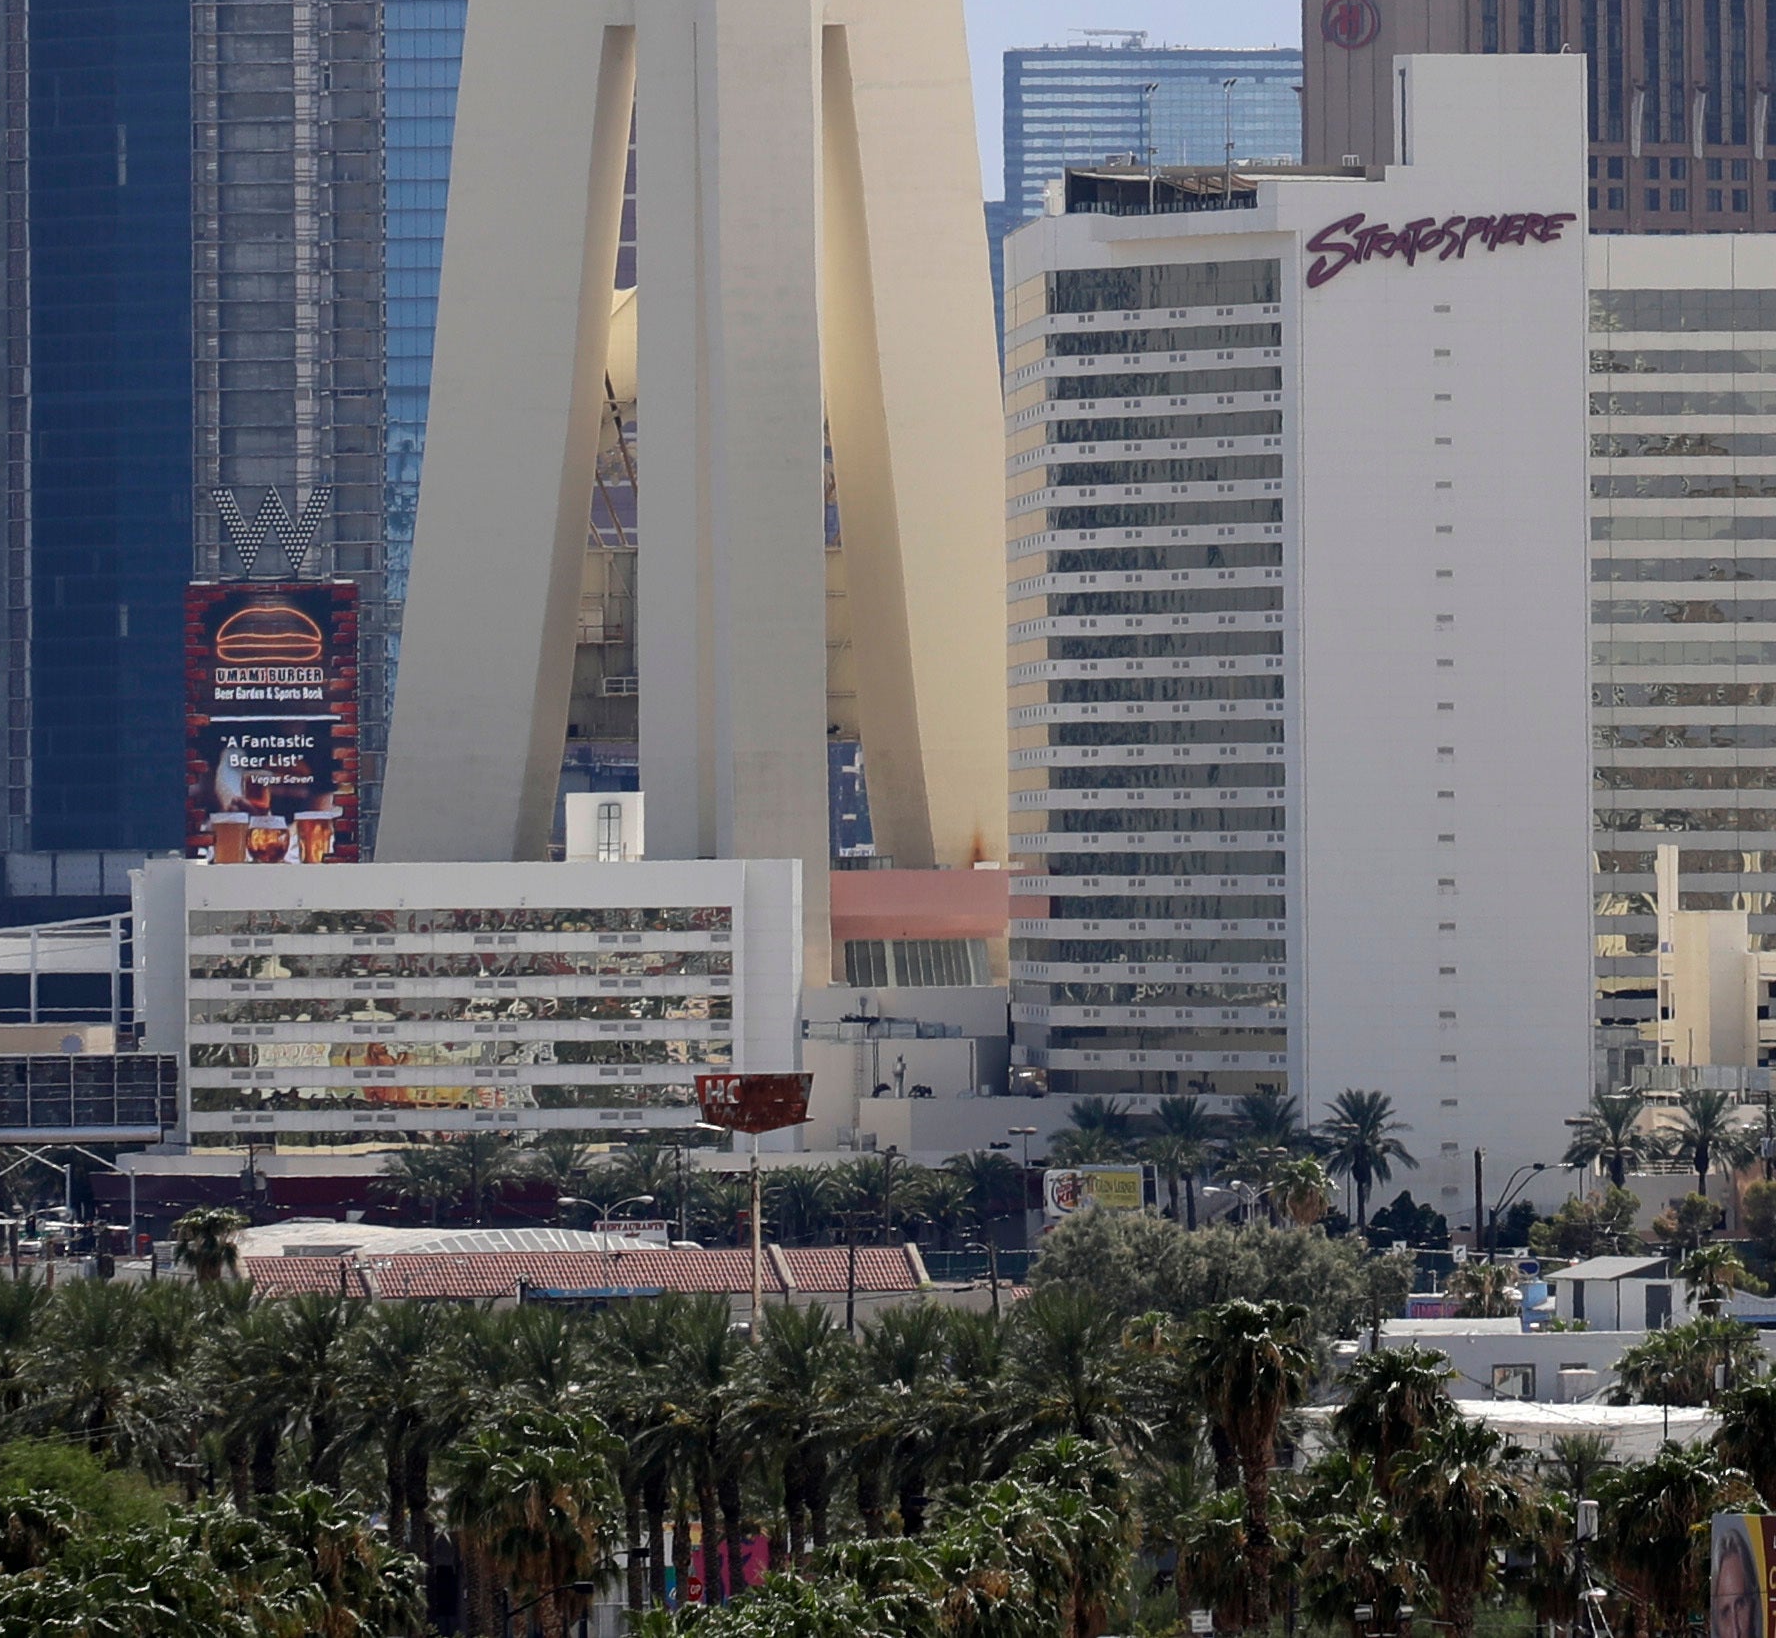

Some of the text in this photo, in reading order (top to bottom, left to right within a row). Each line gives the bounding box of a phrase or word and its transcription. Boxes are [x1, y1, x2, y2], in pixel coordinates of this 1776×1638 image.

[1306, 213, 1576, 288] STRATOSPHERE
[216, 668, 324, 683] UMAMI BURGER
[275, 687, 301, 701] Sports
[242, 735, 315, 747] Fantastic
[230, 754, 265, 767] Beer
[251, 774, 314, 786] Vegas Seven
